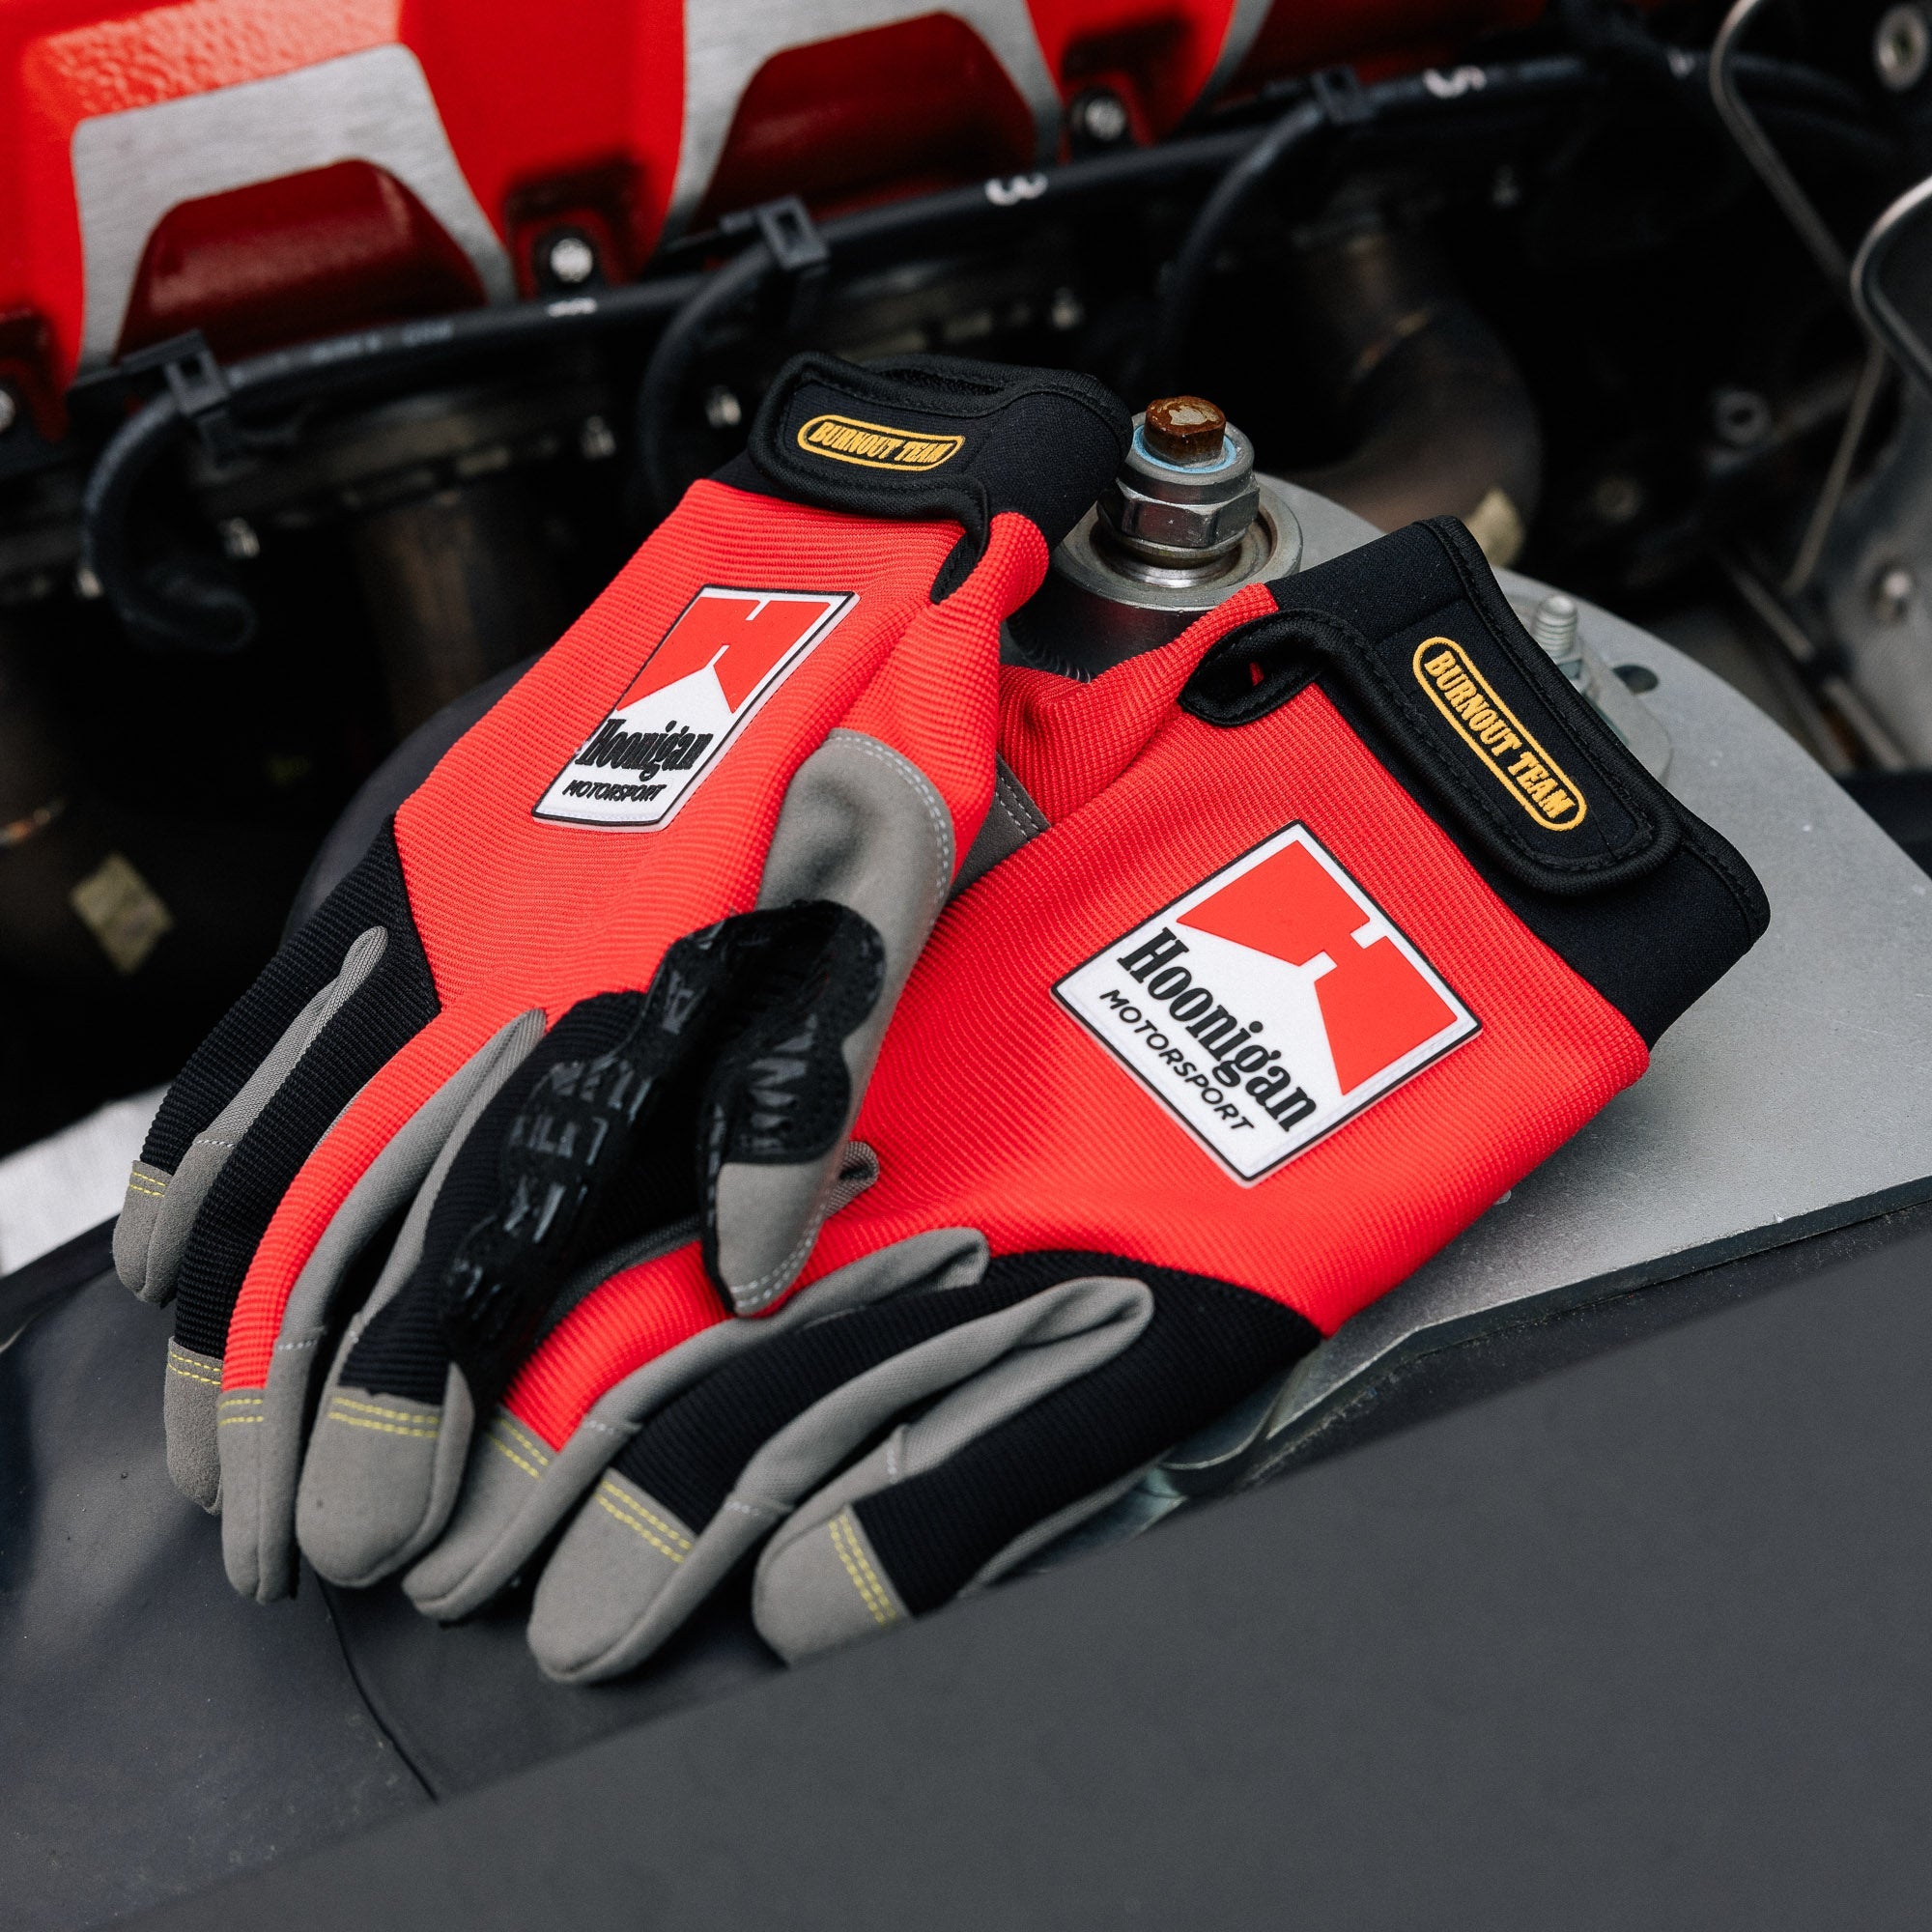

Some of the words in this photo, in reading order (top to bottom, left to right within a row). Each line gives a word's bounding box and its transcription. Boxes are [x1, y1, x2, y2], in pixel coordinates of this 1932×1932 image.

[985, 174, 1047, 206] 3
[808, 421, 901, 460] BURNOUT
[894, 440, 954, 464] TEAM
[575, 719, 713, 782] Hoonigan
[1424, 650, 1522, 756] BURNOUT
[1507, 751, 1577, 819] TEAM
[562, 780, 667, 802] MOTORSPORT
[1098, 988, 1255, 1131] MOTORSPORT
[1117, 926, 1318, 1133] Hoonigan
